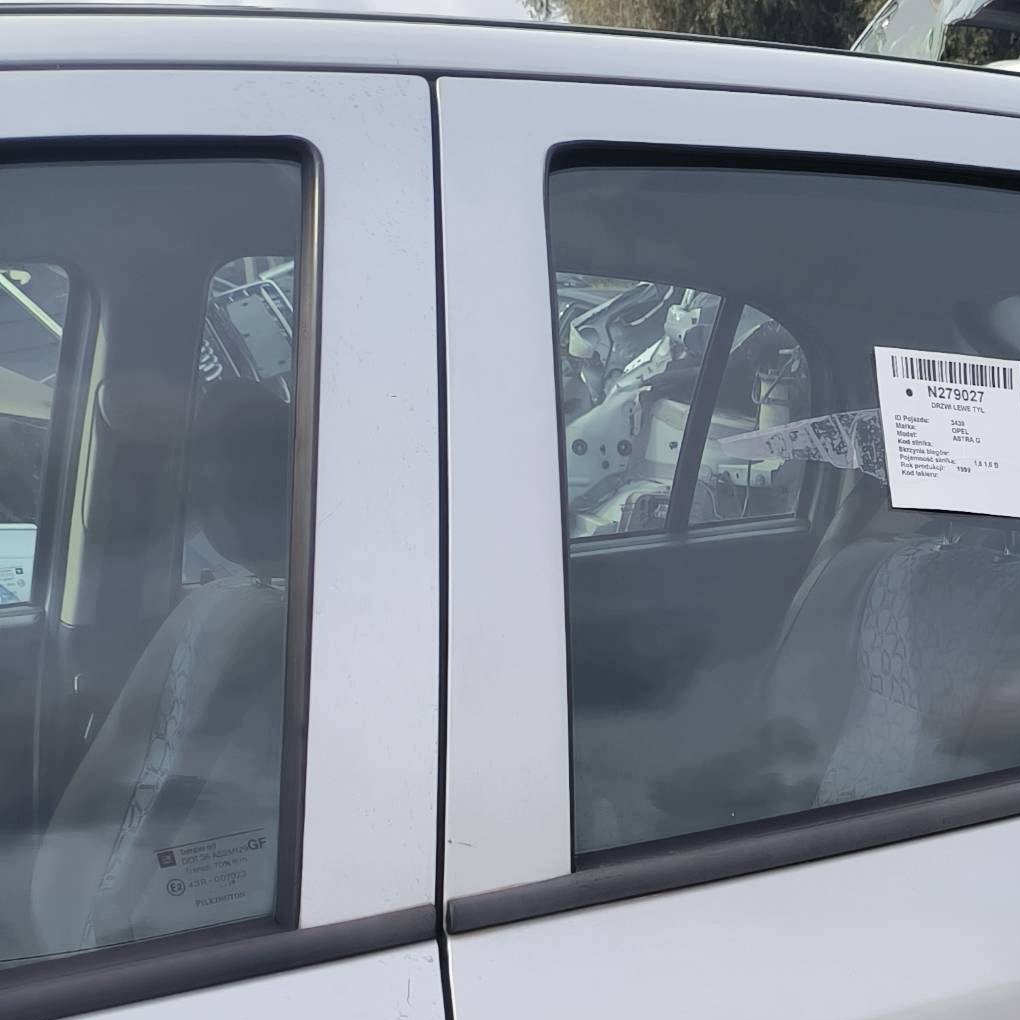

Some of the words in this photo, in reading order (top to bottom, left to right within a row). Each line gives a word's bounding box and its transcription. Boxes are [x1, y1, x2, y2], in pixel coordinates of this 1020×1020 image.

[928, 386, 985, 403] N279027
[931, 402, 951, 411] DRZWI
[953, 404, 972, 413] LEWE
[953, 435, 975, 443] ASTRA
[247, 836, 267, 850] GF
